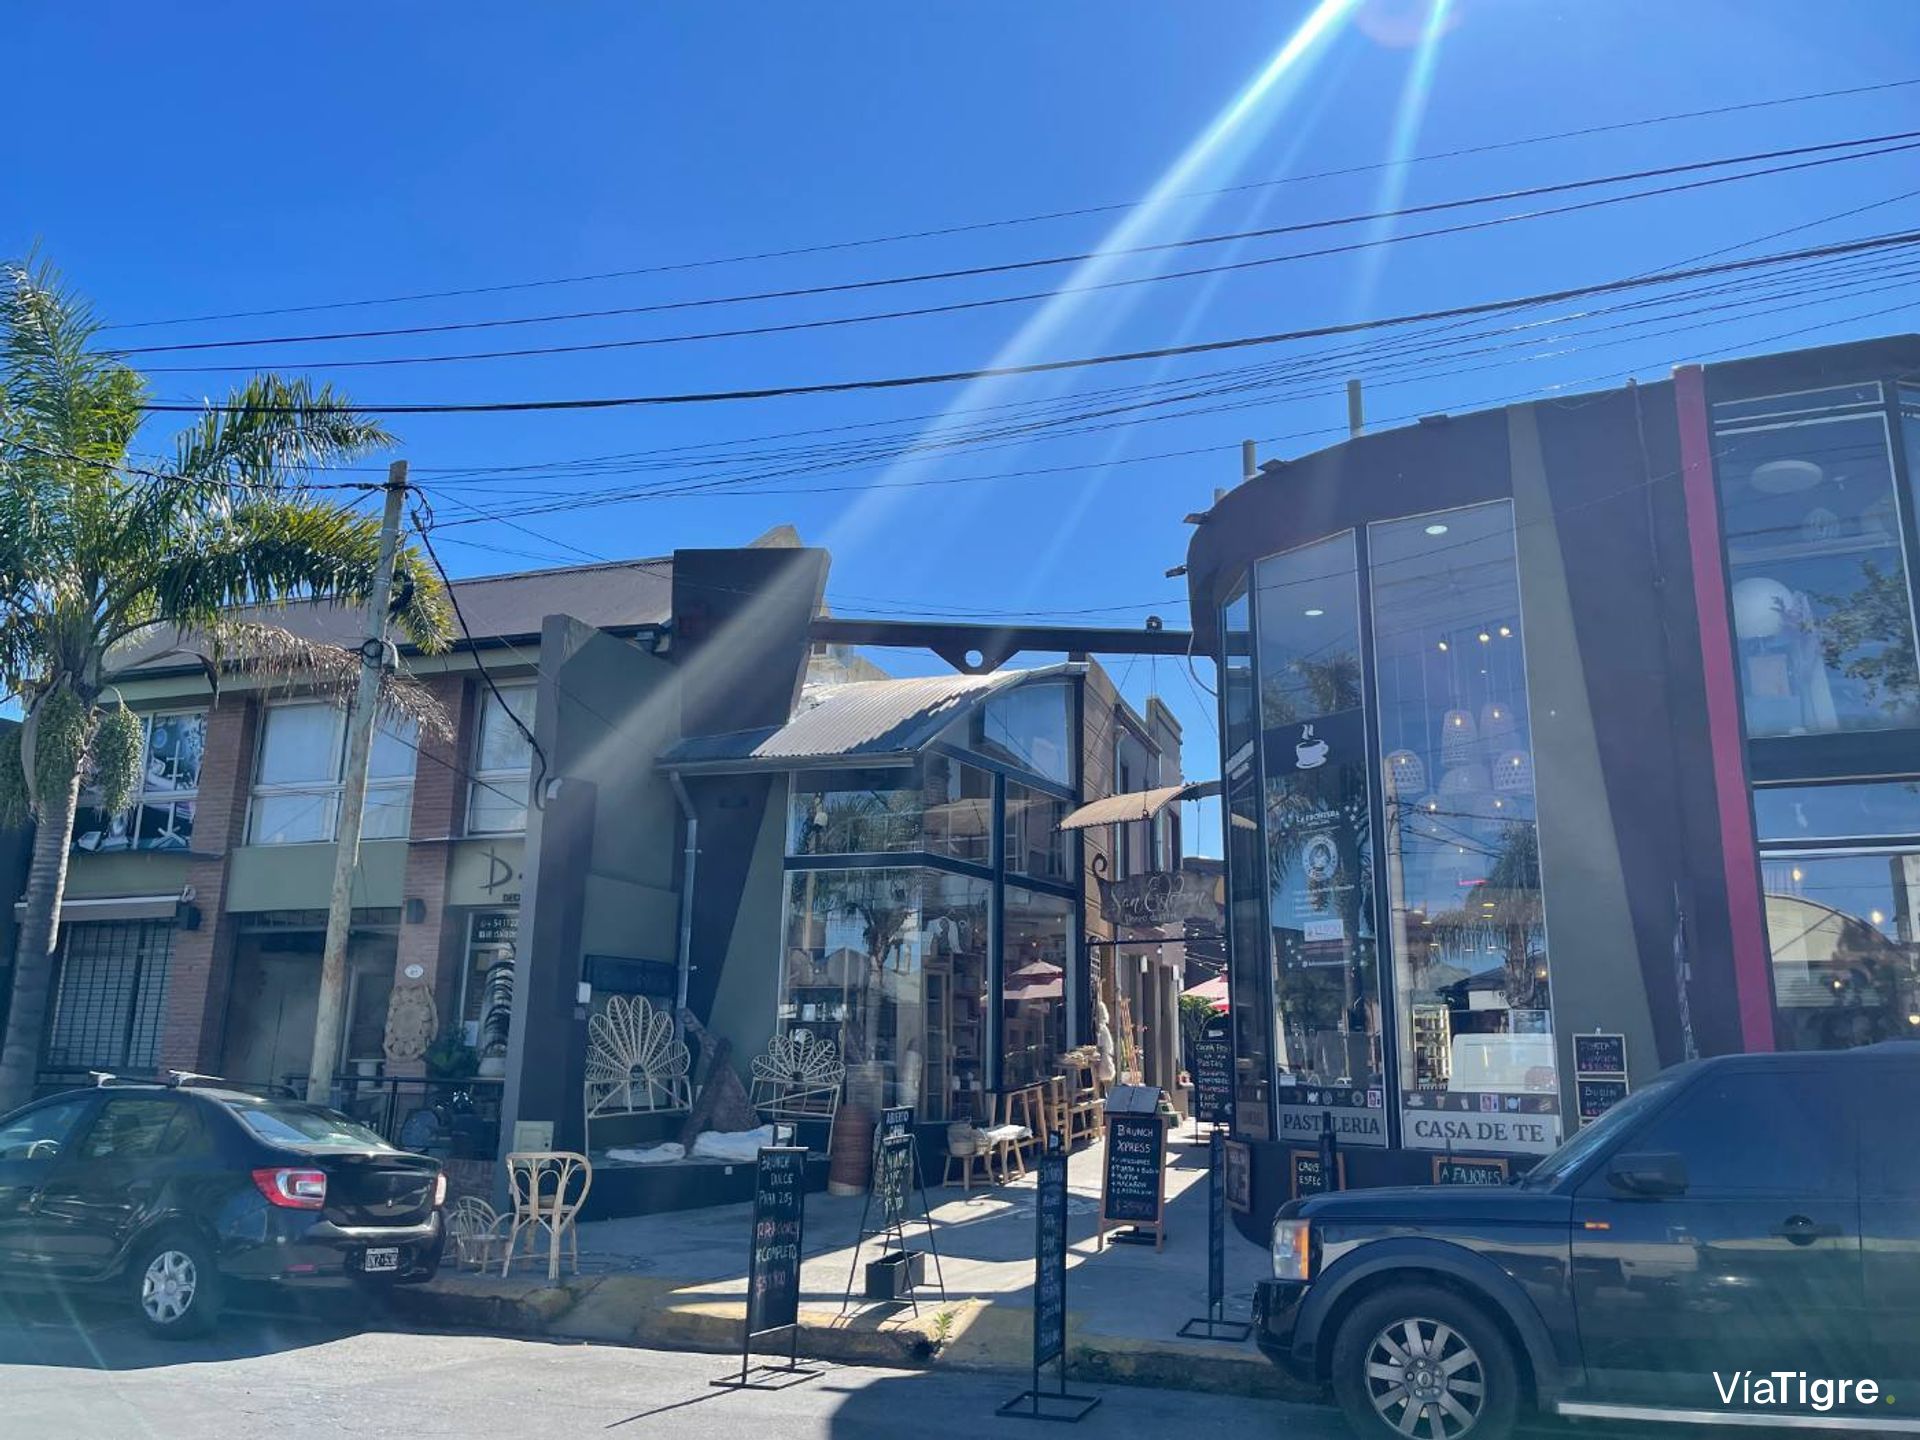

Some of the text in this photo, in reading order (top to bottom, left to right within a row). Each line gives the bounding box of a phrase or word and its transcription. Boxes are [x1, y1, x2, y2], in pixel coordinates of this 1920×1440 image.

[1117, 1124, 1154, 1137] BRUNCH
[1283, 1113, 1380, 1134] PASTLERIA
[1415, 1120, 1545, 1142] CASA DE TE
[1117, 1140, 1153, 1153] XPRESS
[1441, 1166, 1501, 1185] AFAJORES
